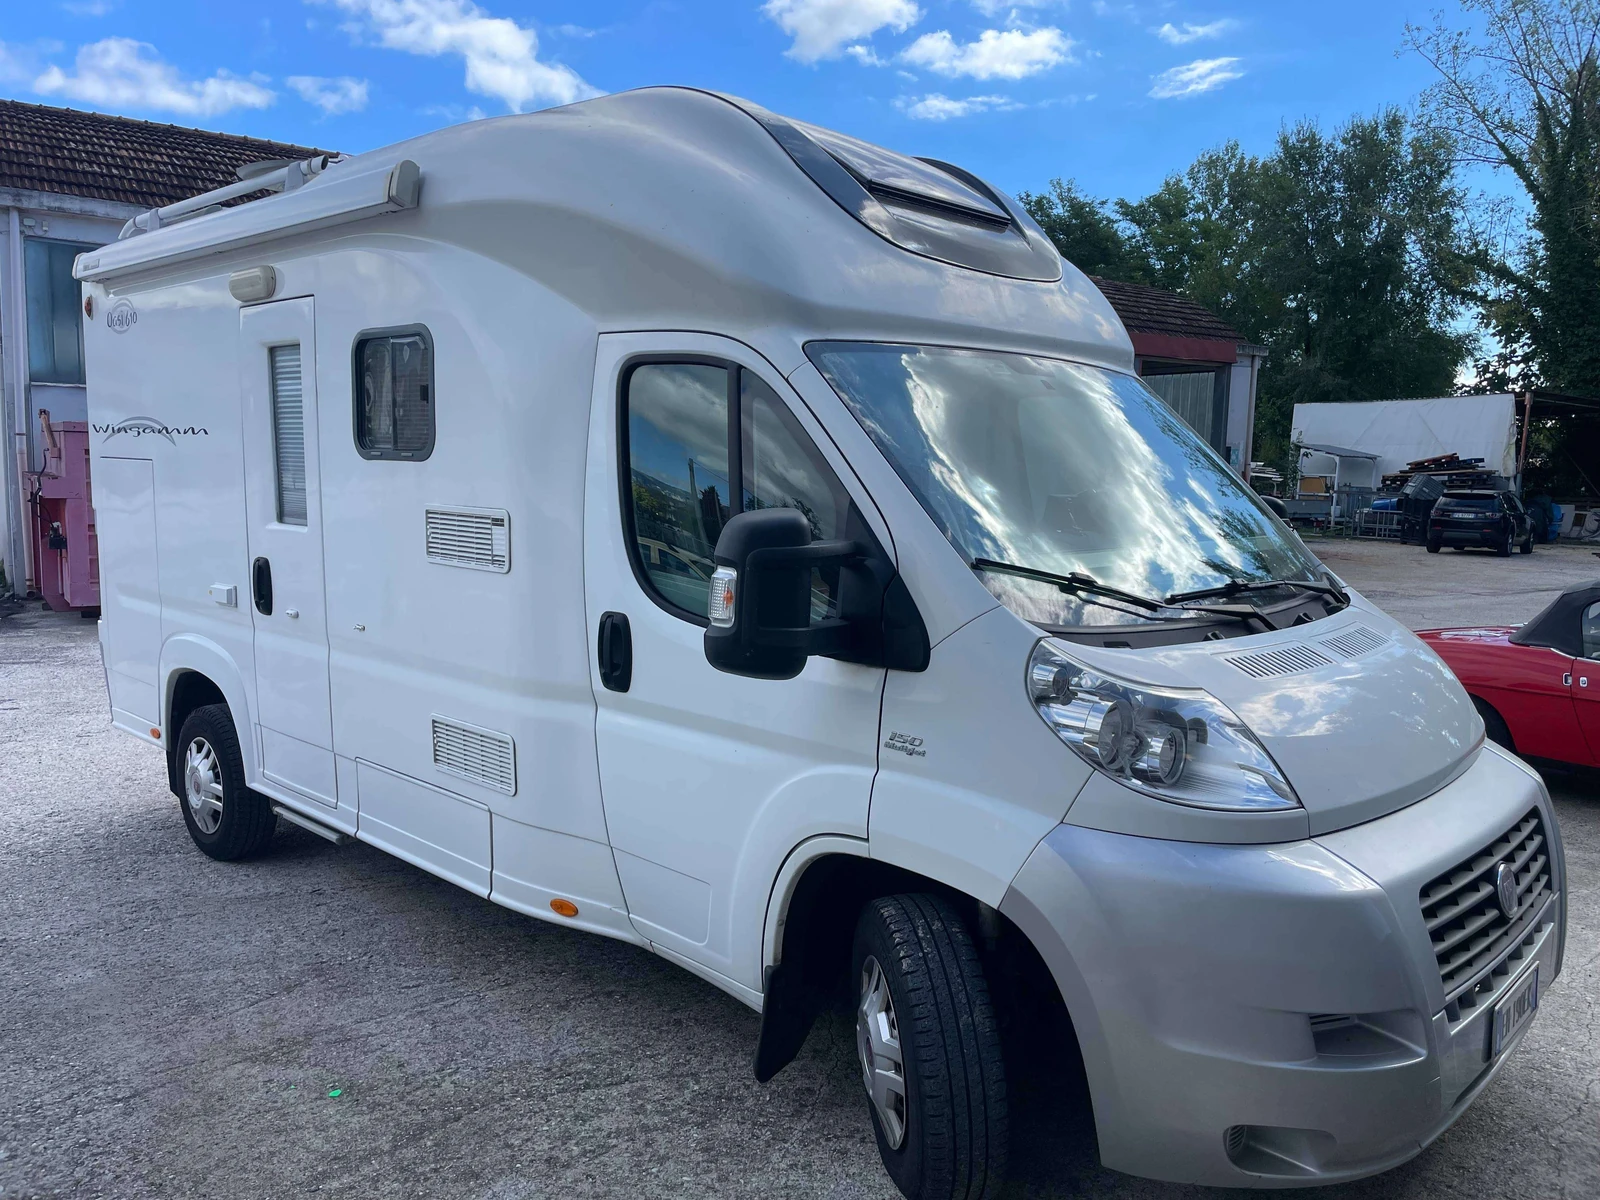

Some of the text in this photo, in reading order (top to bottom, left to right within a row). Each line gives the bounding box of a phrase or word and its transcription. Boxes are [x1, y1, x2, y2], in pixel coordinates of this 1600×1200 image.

[126, 310, 138, 327] 610
[92, 423, 209, 438] Wingamm
[889, 731, 924, 747] 150
